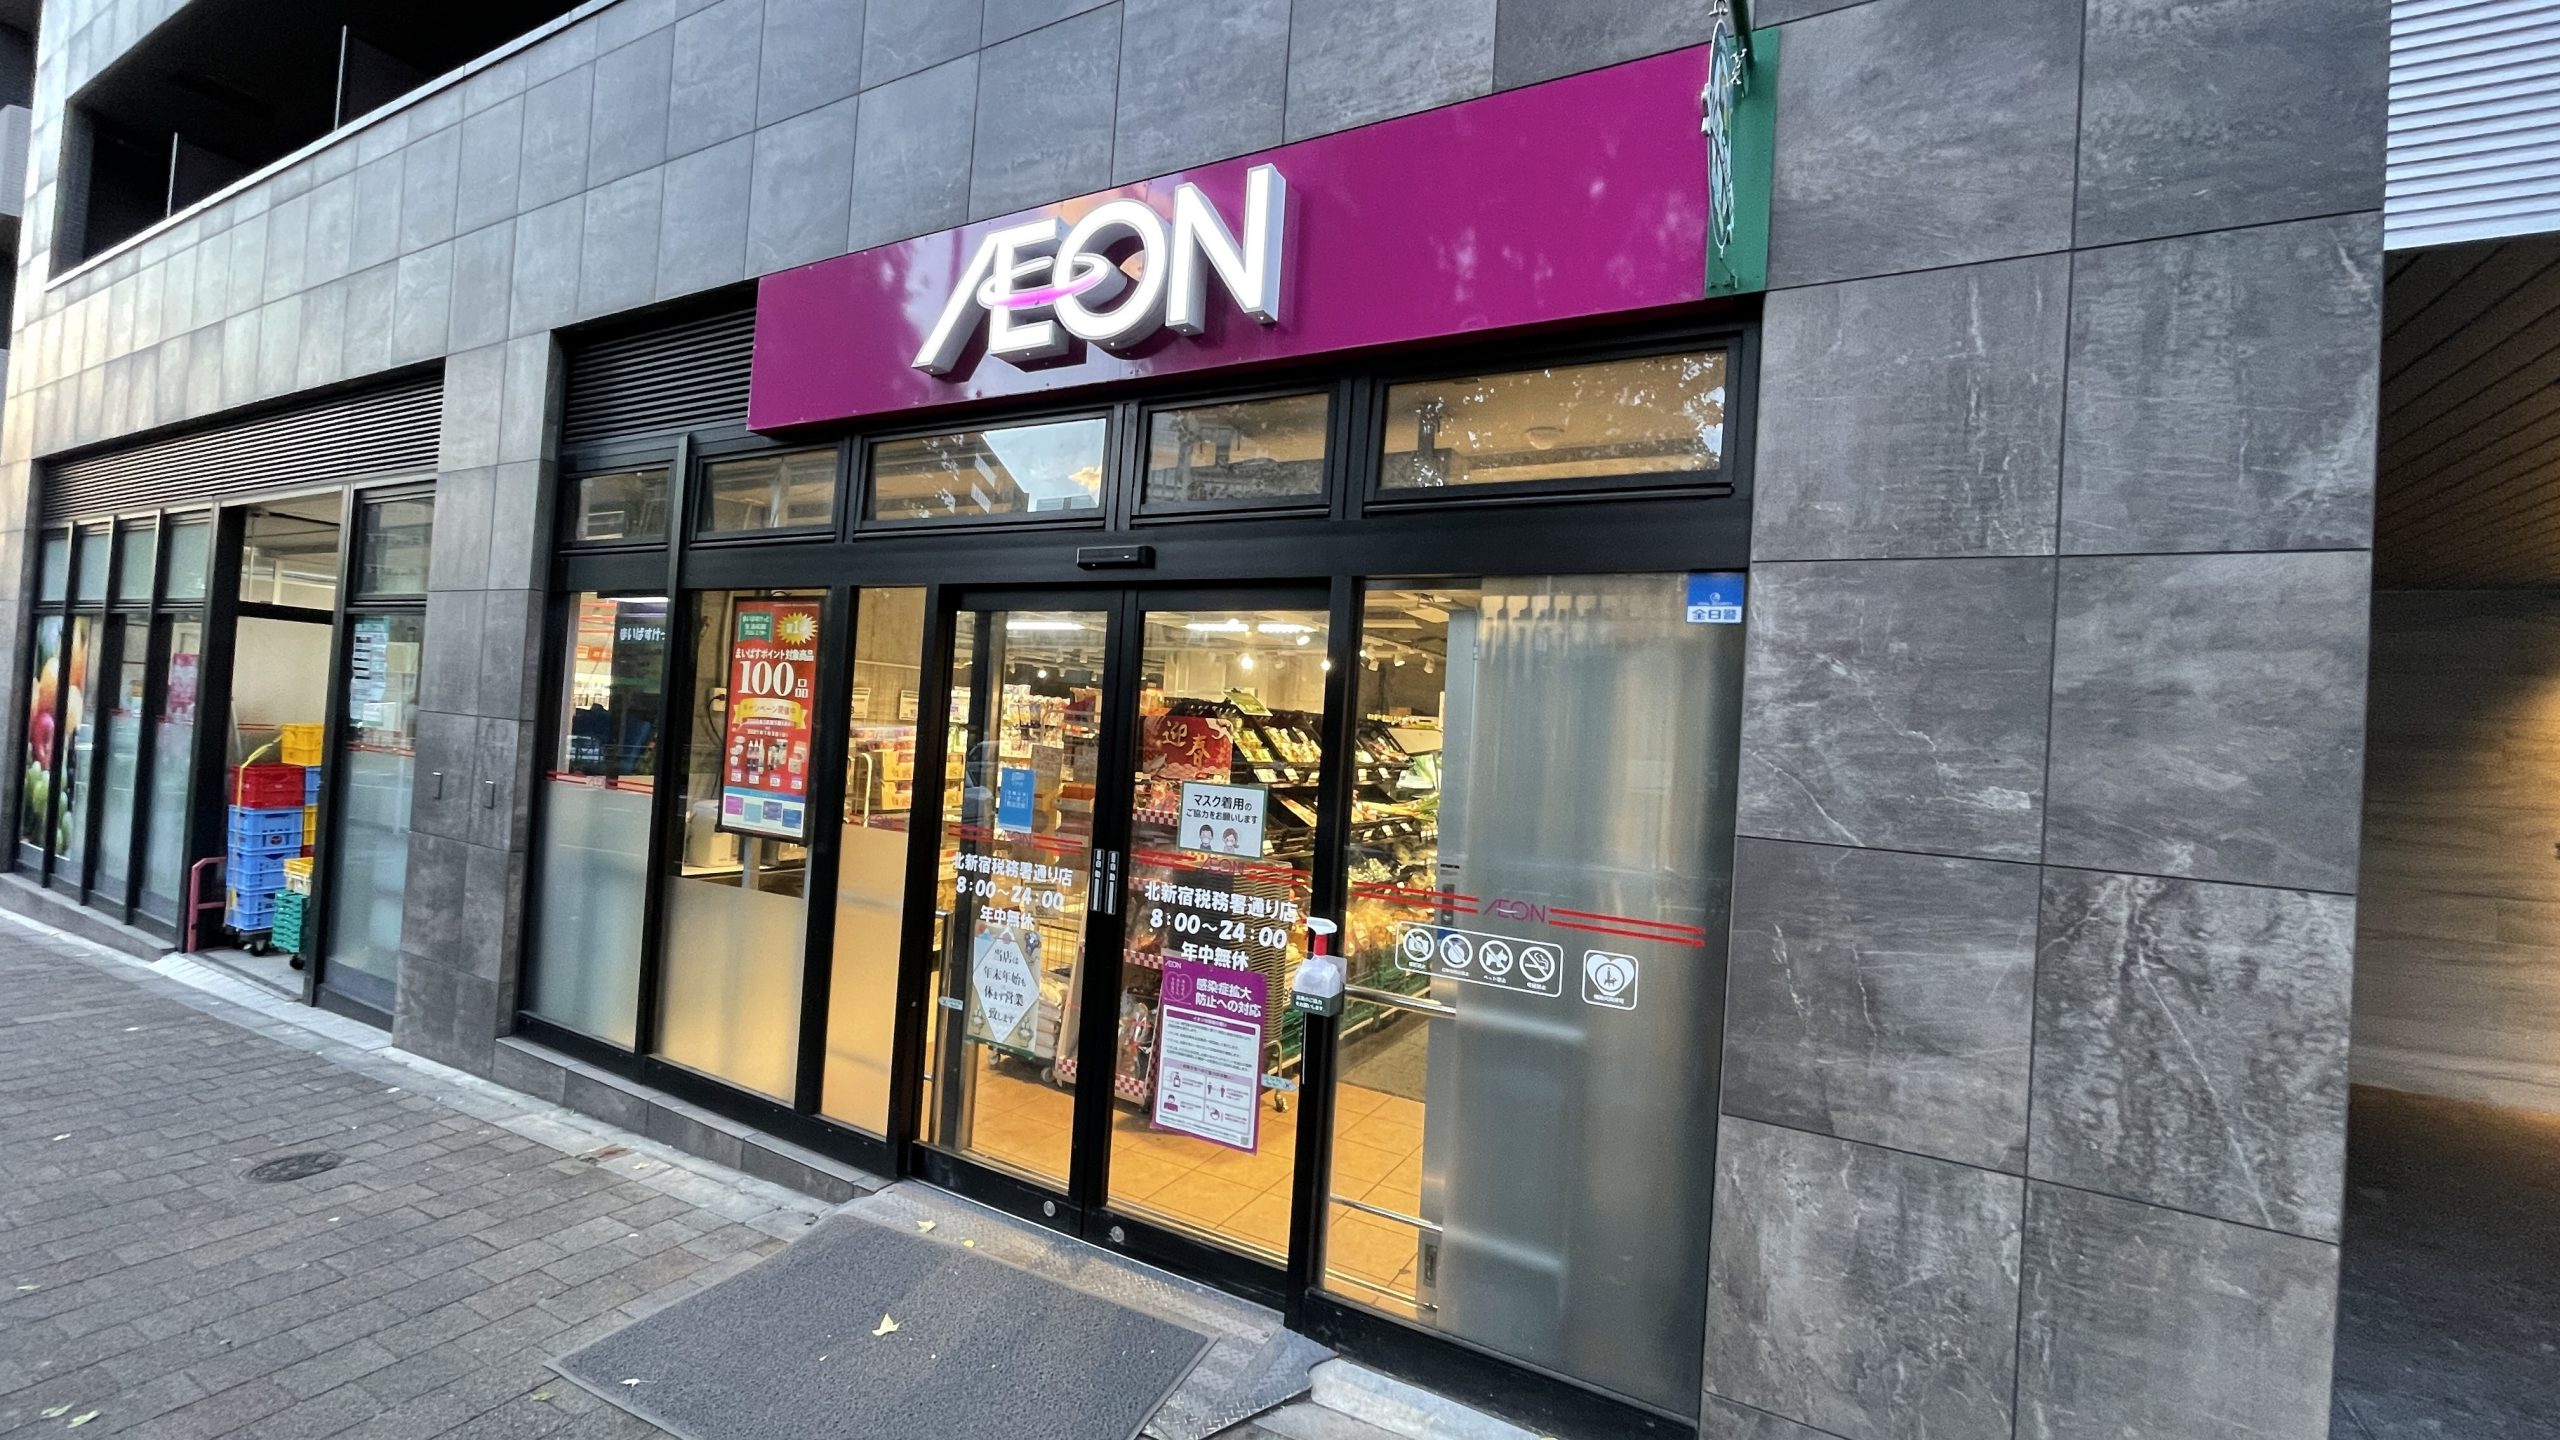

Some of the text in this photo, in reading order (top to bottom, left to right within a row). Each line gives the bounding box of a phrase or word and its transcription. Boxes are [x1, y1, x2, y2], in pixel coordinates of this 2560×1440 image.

[737, 660, 809, 698] 100品
[1186, 808, 1258, 824] ご協力をお願いします
[1193, 794, 1253, 811] マスク着用の
[954, 851, 1073, 887] 北新宿税務署通り店
[1144, 881, 1299, 924] 北新宿税務署通り店
[980, 904, 1035, 931] 年中無休
[1181, 941, 1249, 972] 年中無休
[1196, 977, 1252, 1001] 感染症拡大
[1195, 992, 1262, 1018] 防止への対応
